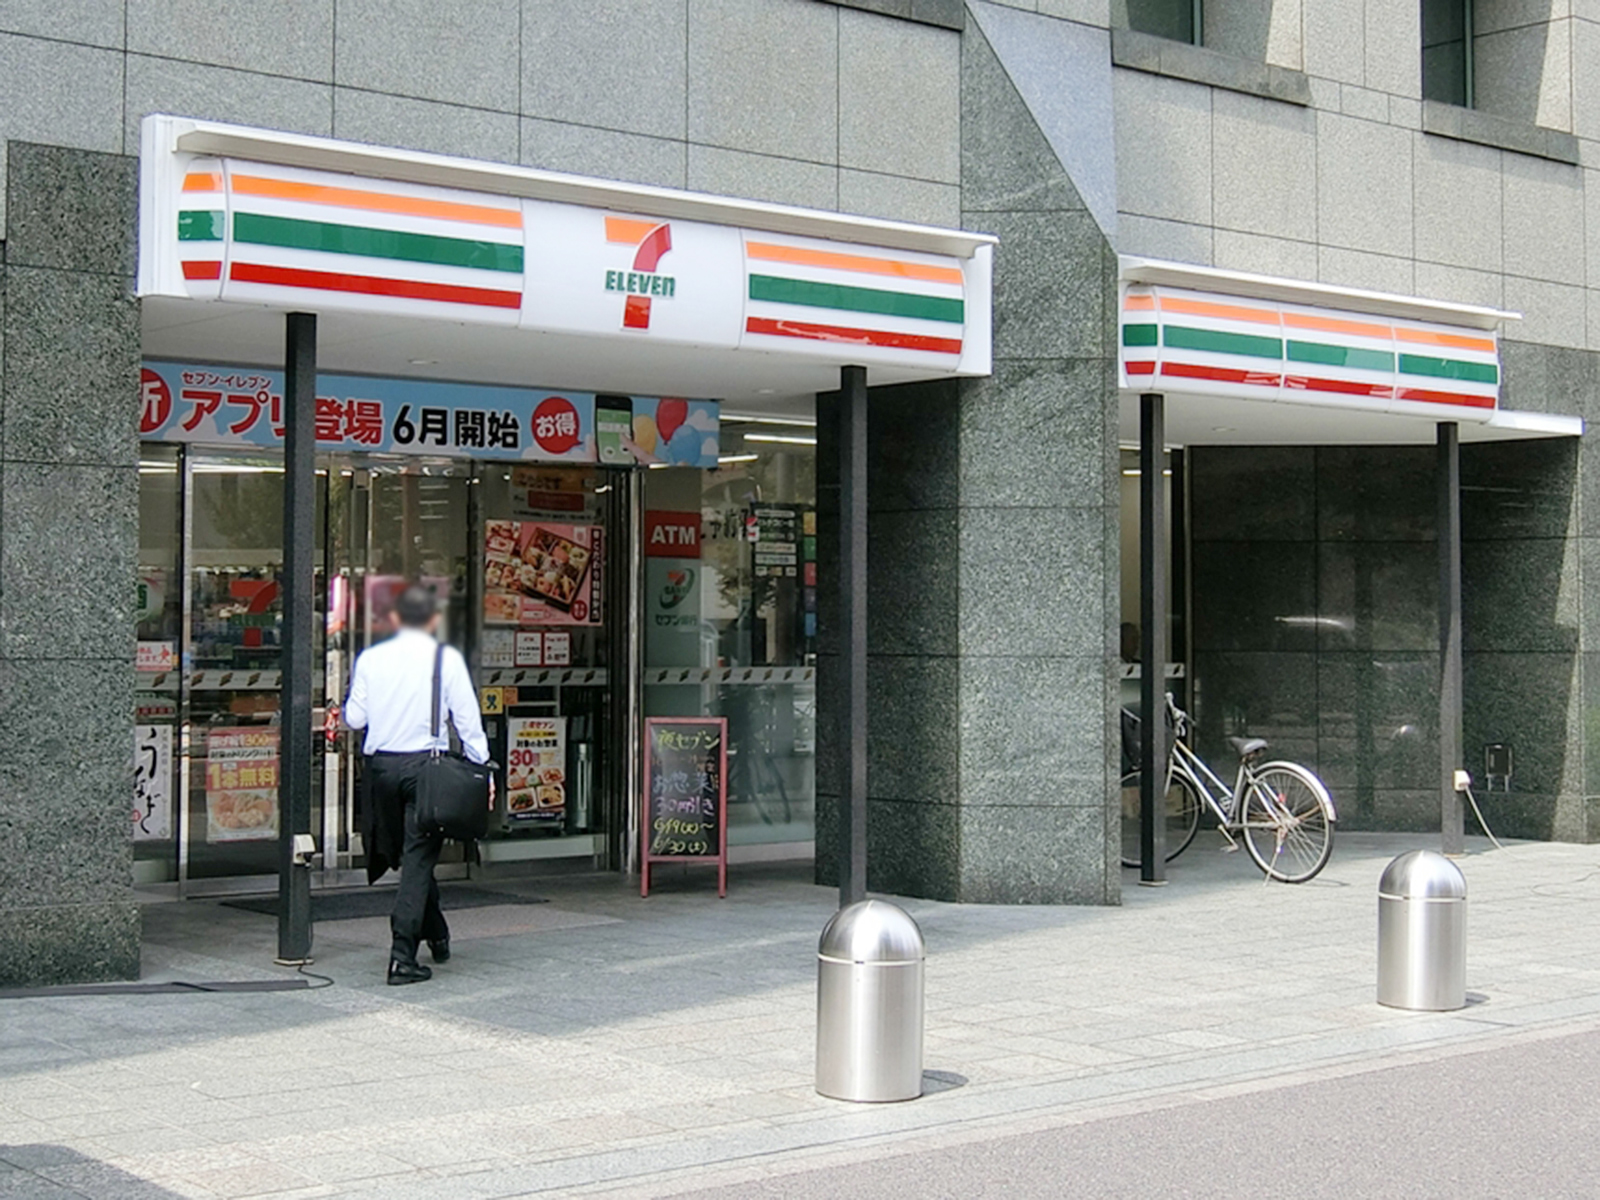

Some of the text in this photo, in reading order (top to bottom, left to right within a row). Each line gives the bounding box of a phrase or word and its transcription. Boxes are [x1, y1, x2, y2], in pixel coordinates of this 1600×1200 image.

[393, 404, 519, 448] 6月開始
[535, 411, 576, 438] お得
[650, 525, 696, 545] ATM
[209, 763, 276, 789] 1本無料
